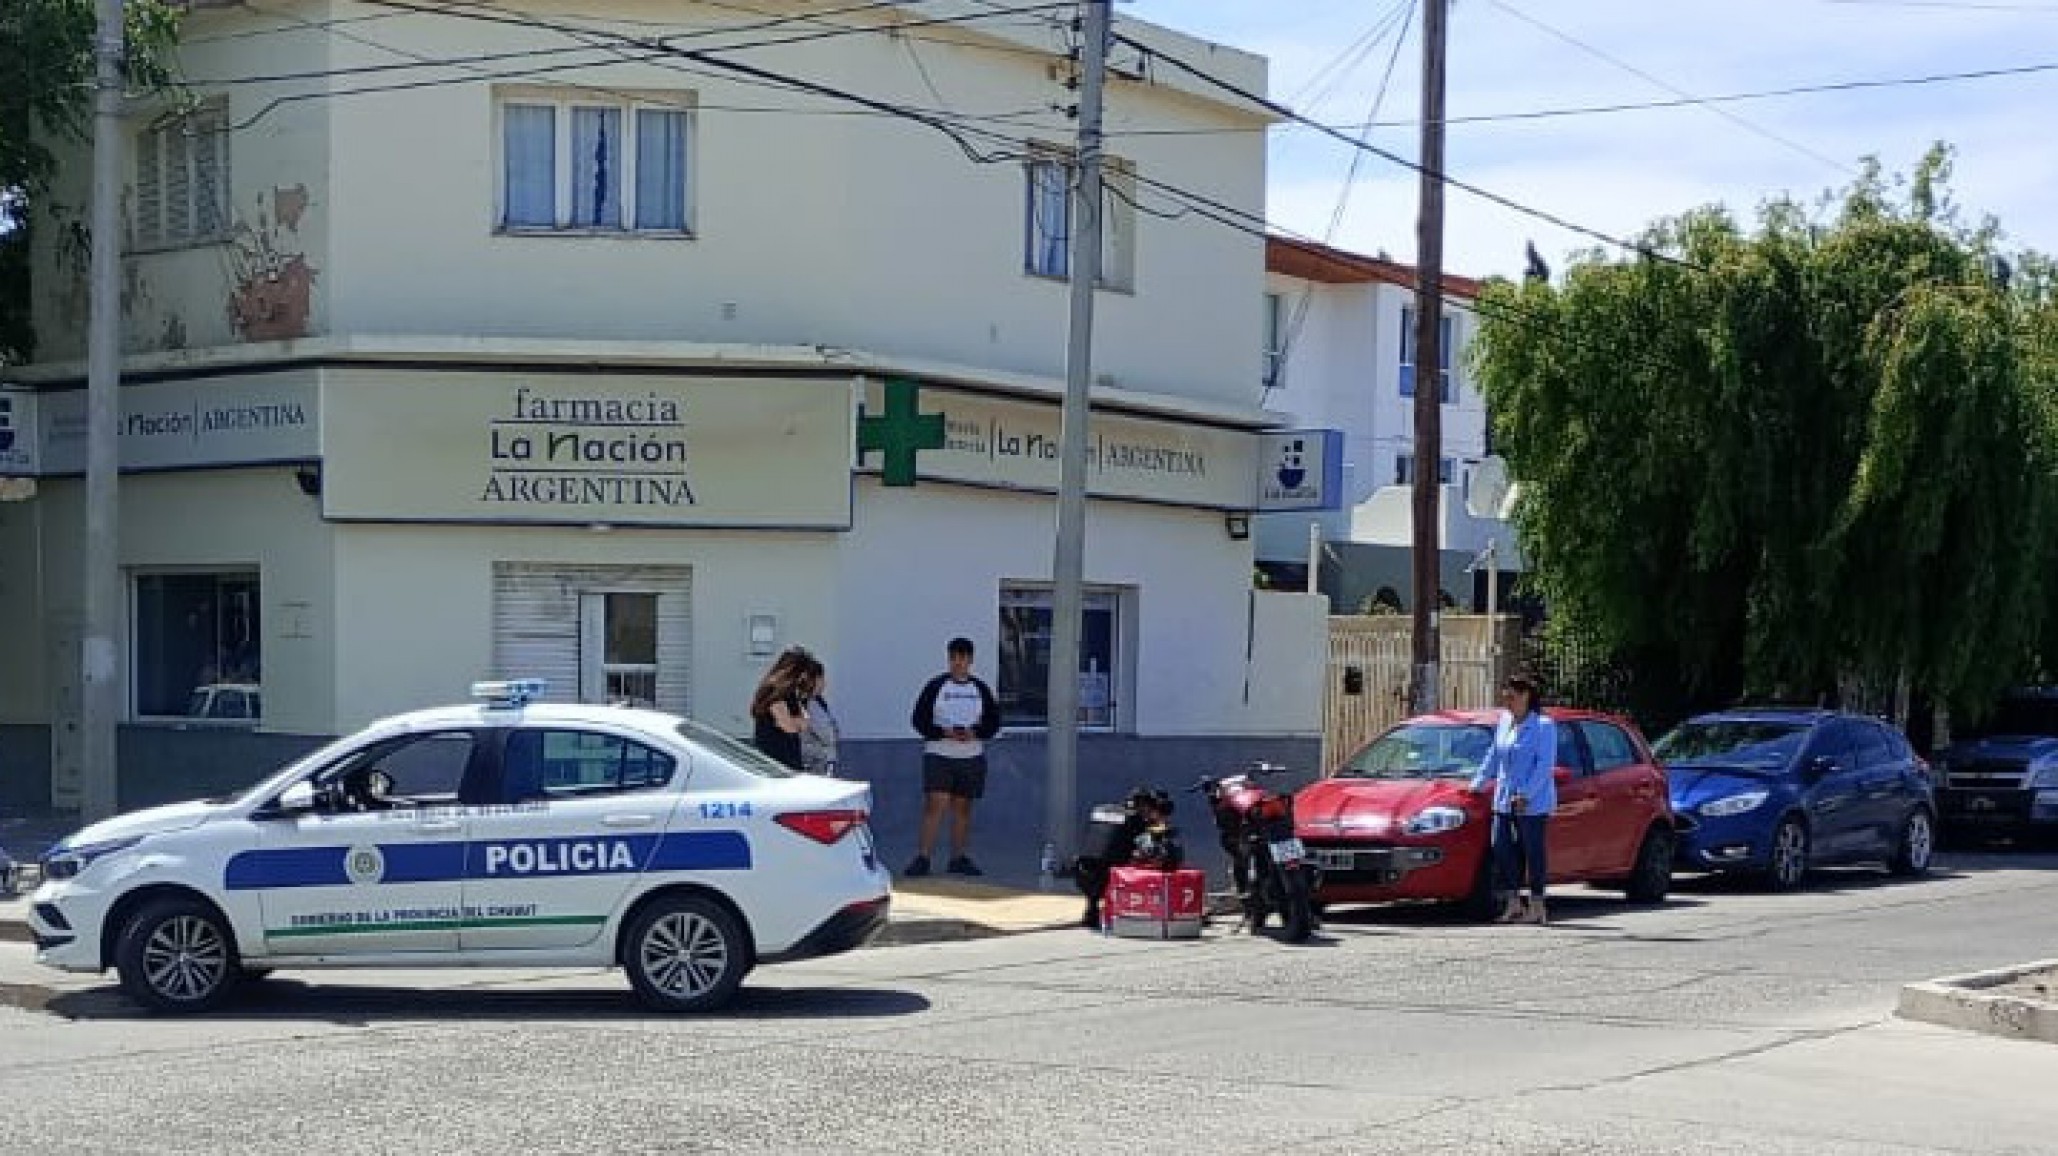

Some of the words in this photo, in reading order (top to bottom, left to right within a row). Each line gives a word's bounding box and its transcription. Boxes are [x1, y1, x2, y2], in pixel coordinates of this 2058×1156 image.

[202, 405, 305, 433] ARGENTINA
[513, 387, 680, 422] farmacia
[491, 430, 532, 460] La
[547, 431, 688, 463] Nación
[998, 427, 1020, 456] La
[1106, 442, 1206, 477] ARGENTINA
[482, 476, 697, 505] ARGENTINA
[700, 801, 753, 819] 1214
[485, 841, 635, 873] POLICIA
[394, 908, 459, 919] PROVINCIA
